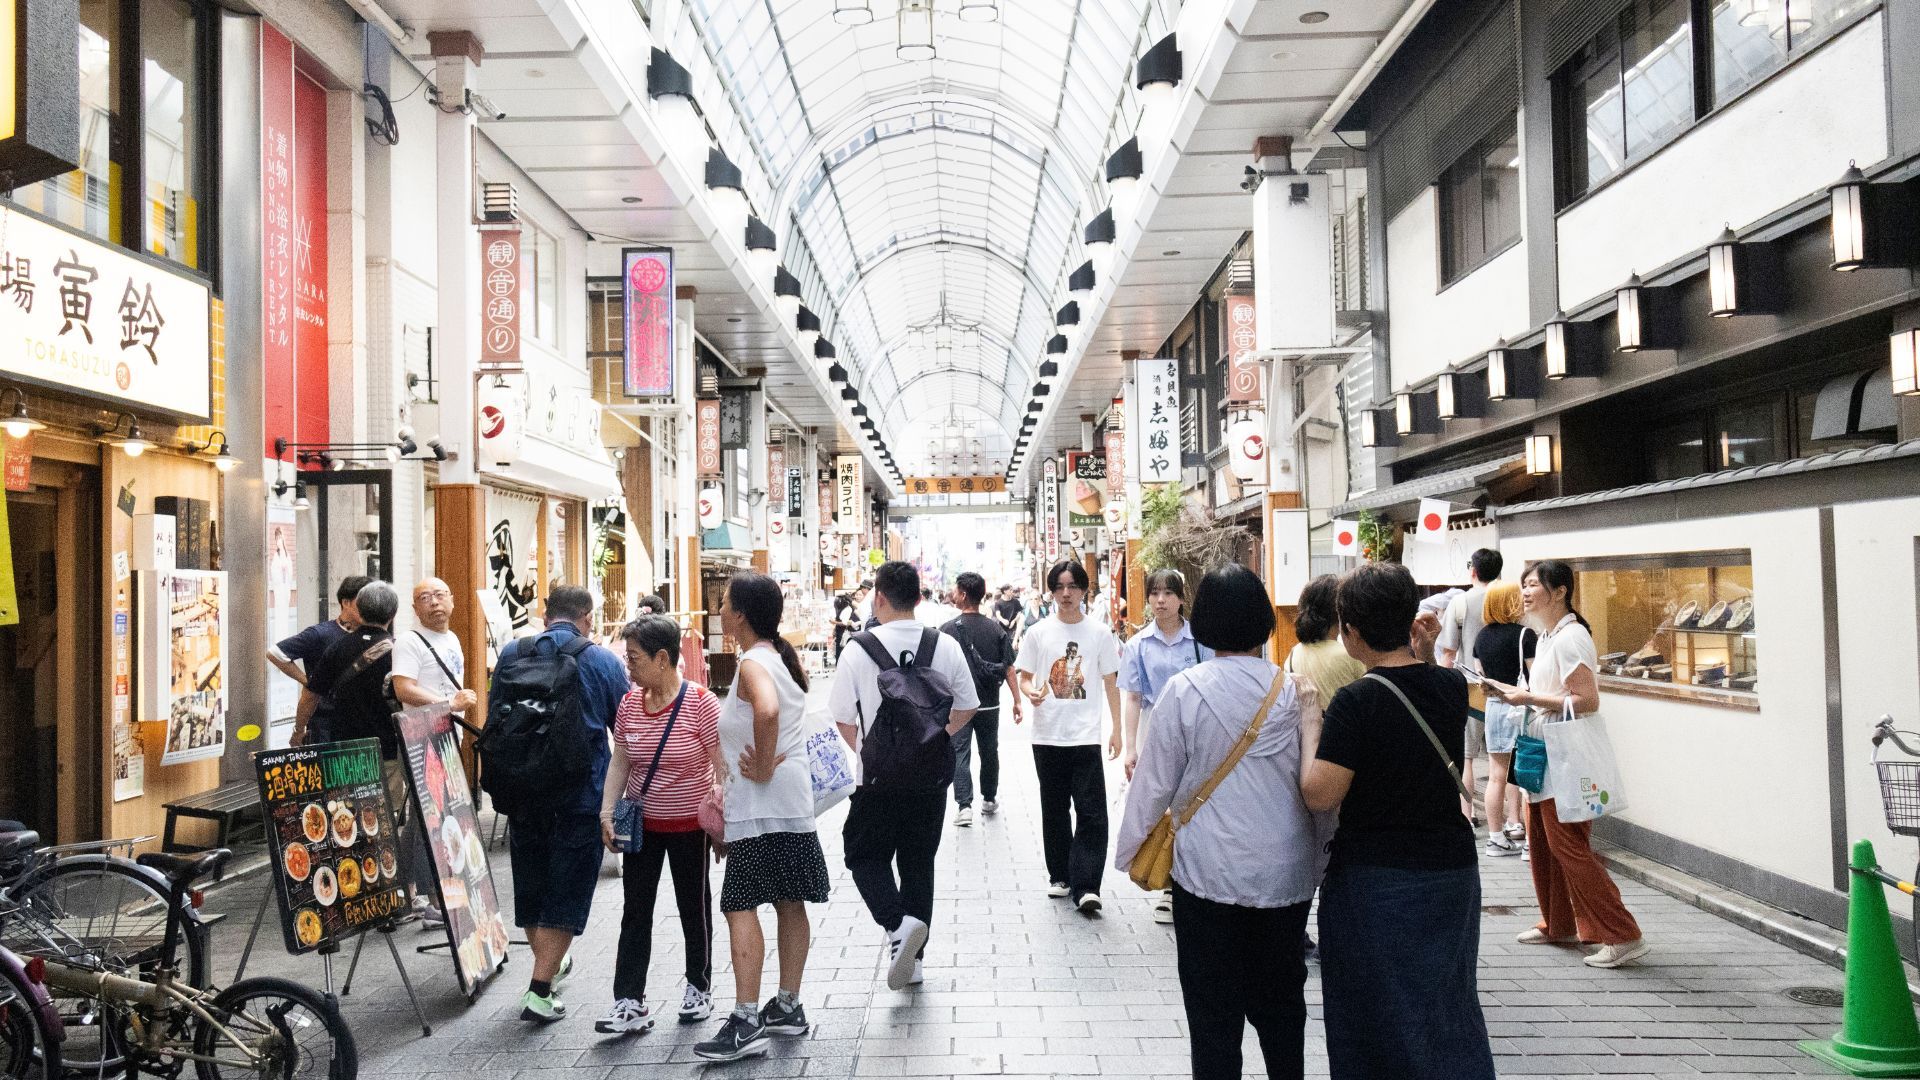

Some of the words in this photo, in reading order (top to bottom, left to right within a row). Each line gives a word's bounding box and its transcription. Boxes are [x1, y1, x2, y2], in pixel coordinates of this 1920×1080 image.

[267, 127, 276, 225] KIMONO
[276, 132, 289, 347] 着物・浴衣レンタル
[268, 278, 276, 343] RENT
[296, 277, 325, 303] SARA
[487, 240, 516, 353] 観音通り
[24, 336, 111, 377] TORASUZU
[700, 405, 718, 469] 観音通り
[840, 463, 853, 516] 焼肉ライク
[913, 477, 997, 494] 観音通り
